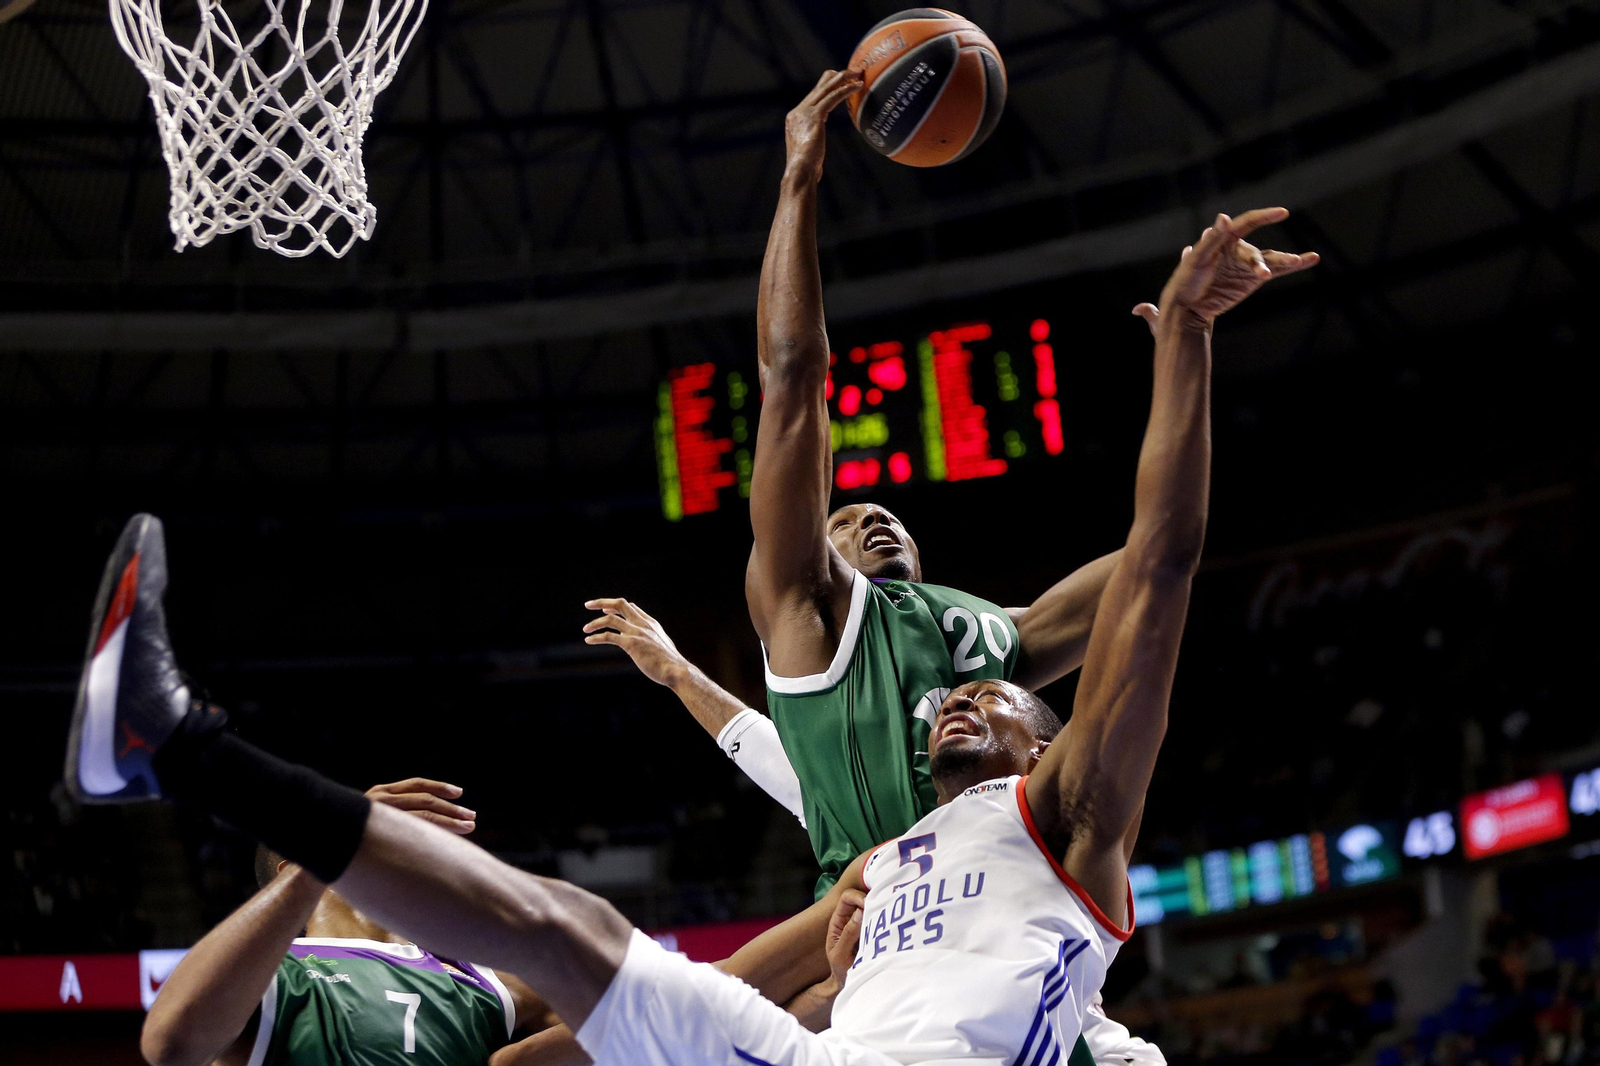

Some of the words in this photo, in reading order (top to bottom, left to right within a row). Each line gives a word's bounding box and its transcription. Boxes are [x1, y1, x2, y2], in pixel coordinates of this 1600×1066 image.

[872, 95, 898, 131] TURKISH
[896, 61, 929, 100] AIRLINES
[879, 68, 936, 137] EUROLEAGUE
[942, 606, 1013, 673] 20
[892, 831, 938, 894] 5
[862, 871, 986, 950] NADOLU
[384, 989, 422, 1054] 7
